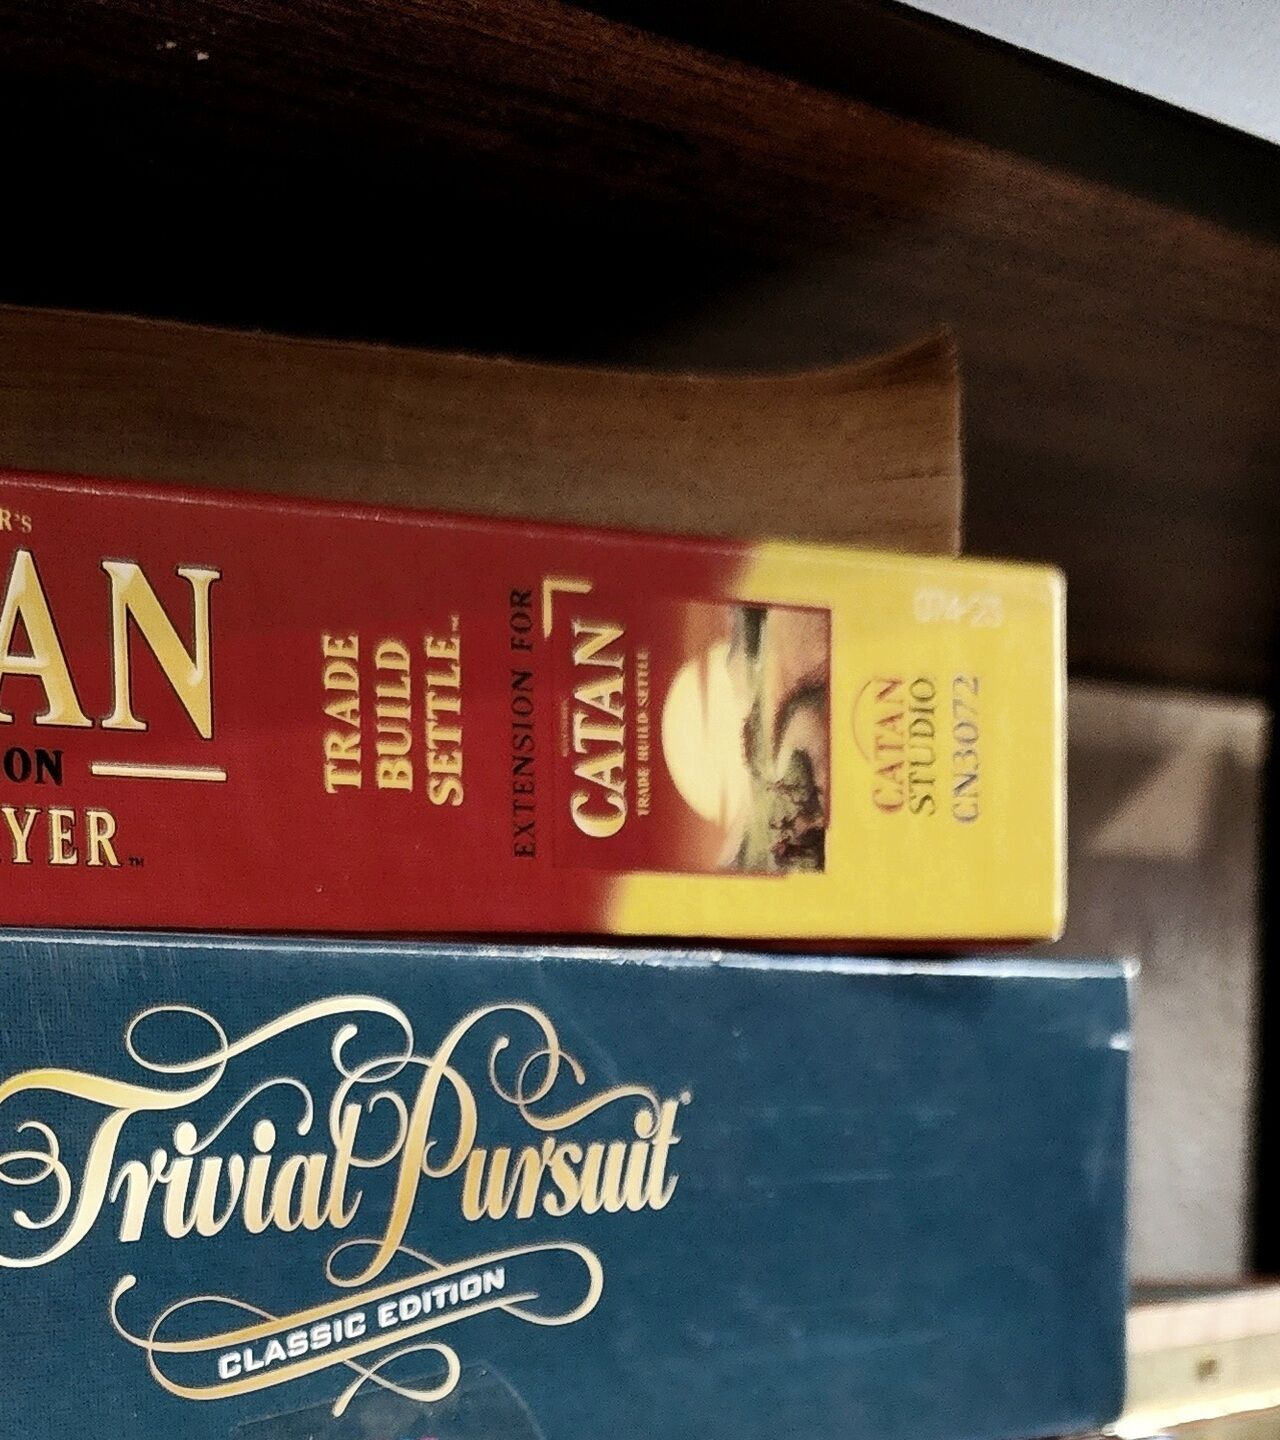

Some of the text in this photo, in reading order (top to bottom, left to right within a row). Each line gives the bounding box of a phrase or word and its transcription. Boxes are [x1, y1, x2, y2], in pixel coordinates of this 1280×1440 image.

[323, 633, 362, 795] TRADE
[375, 639, 413, 791] BUILD
[509, 587, 537, 858] EXTENSION FOR
[570, 619, 628, 838] CATAN
[872, 676, 904, 815] CATAN
[907, 677, 936, 816] STUDIO
[951, 673, 980, 824] CN3072
[325, 1001, 682, 1288] Pursuit
[218, 1265, 506, 1380] CLASSIC EDITION
